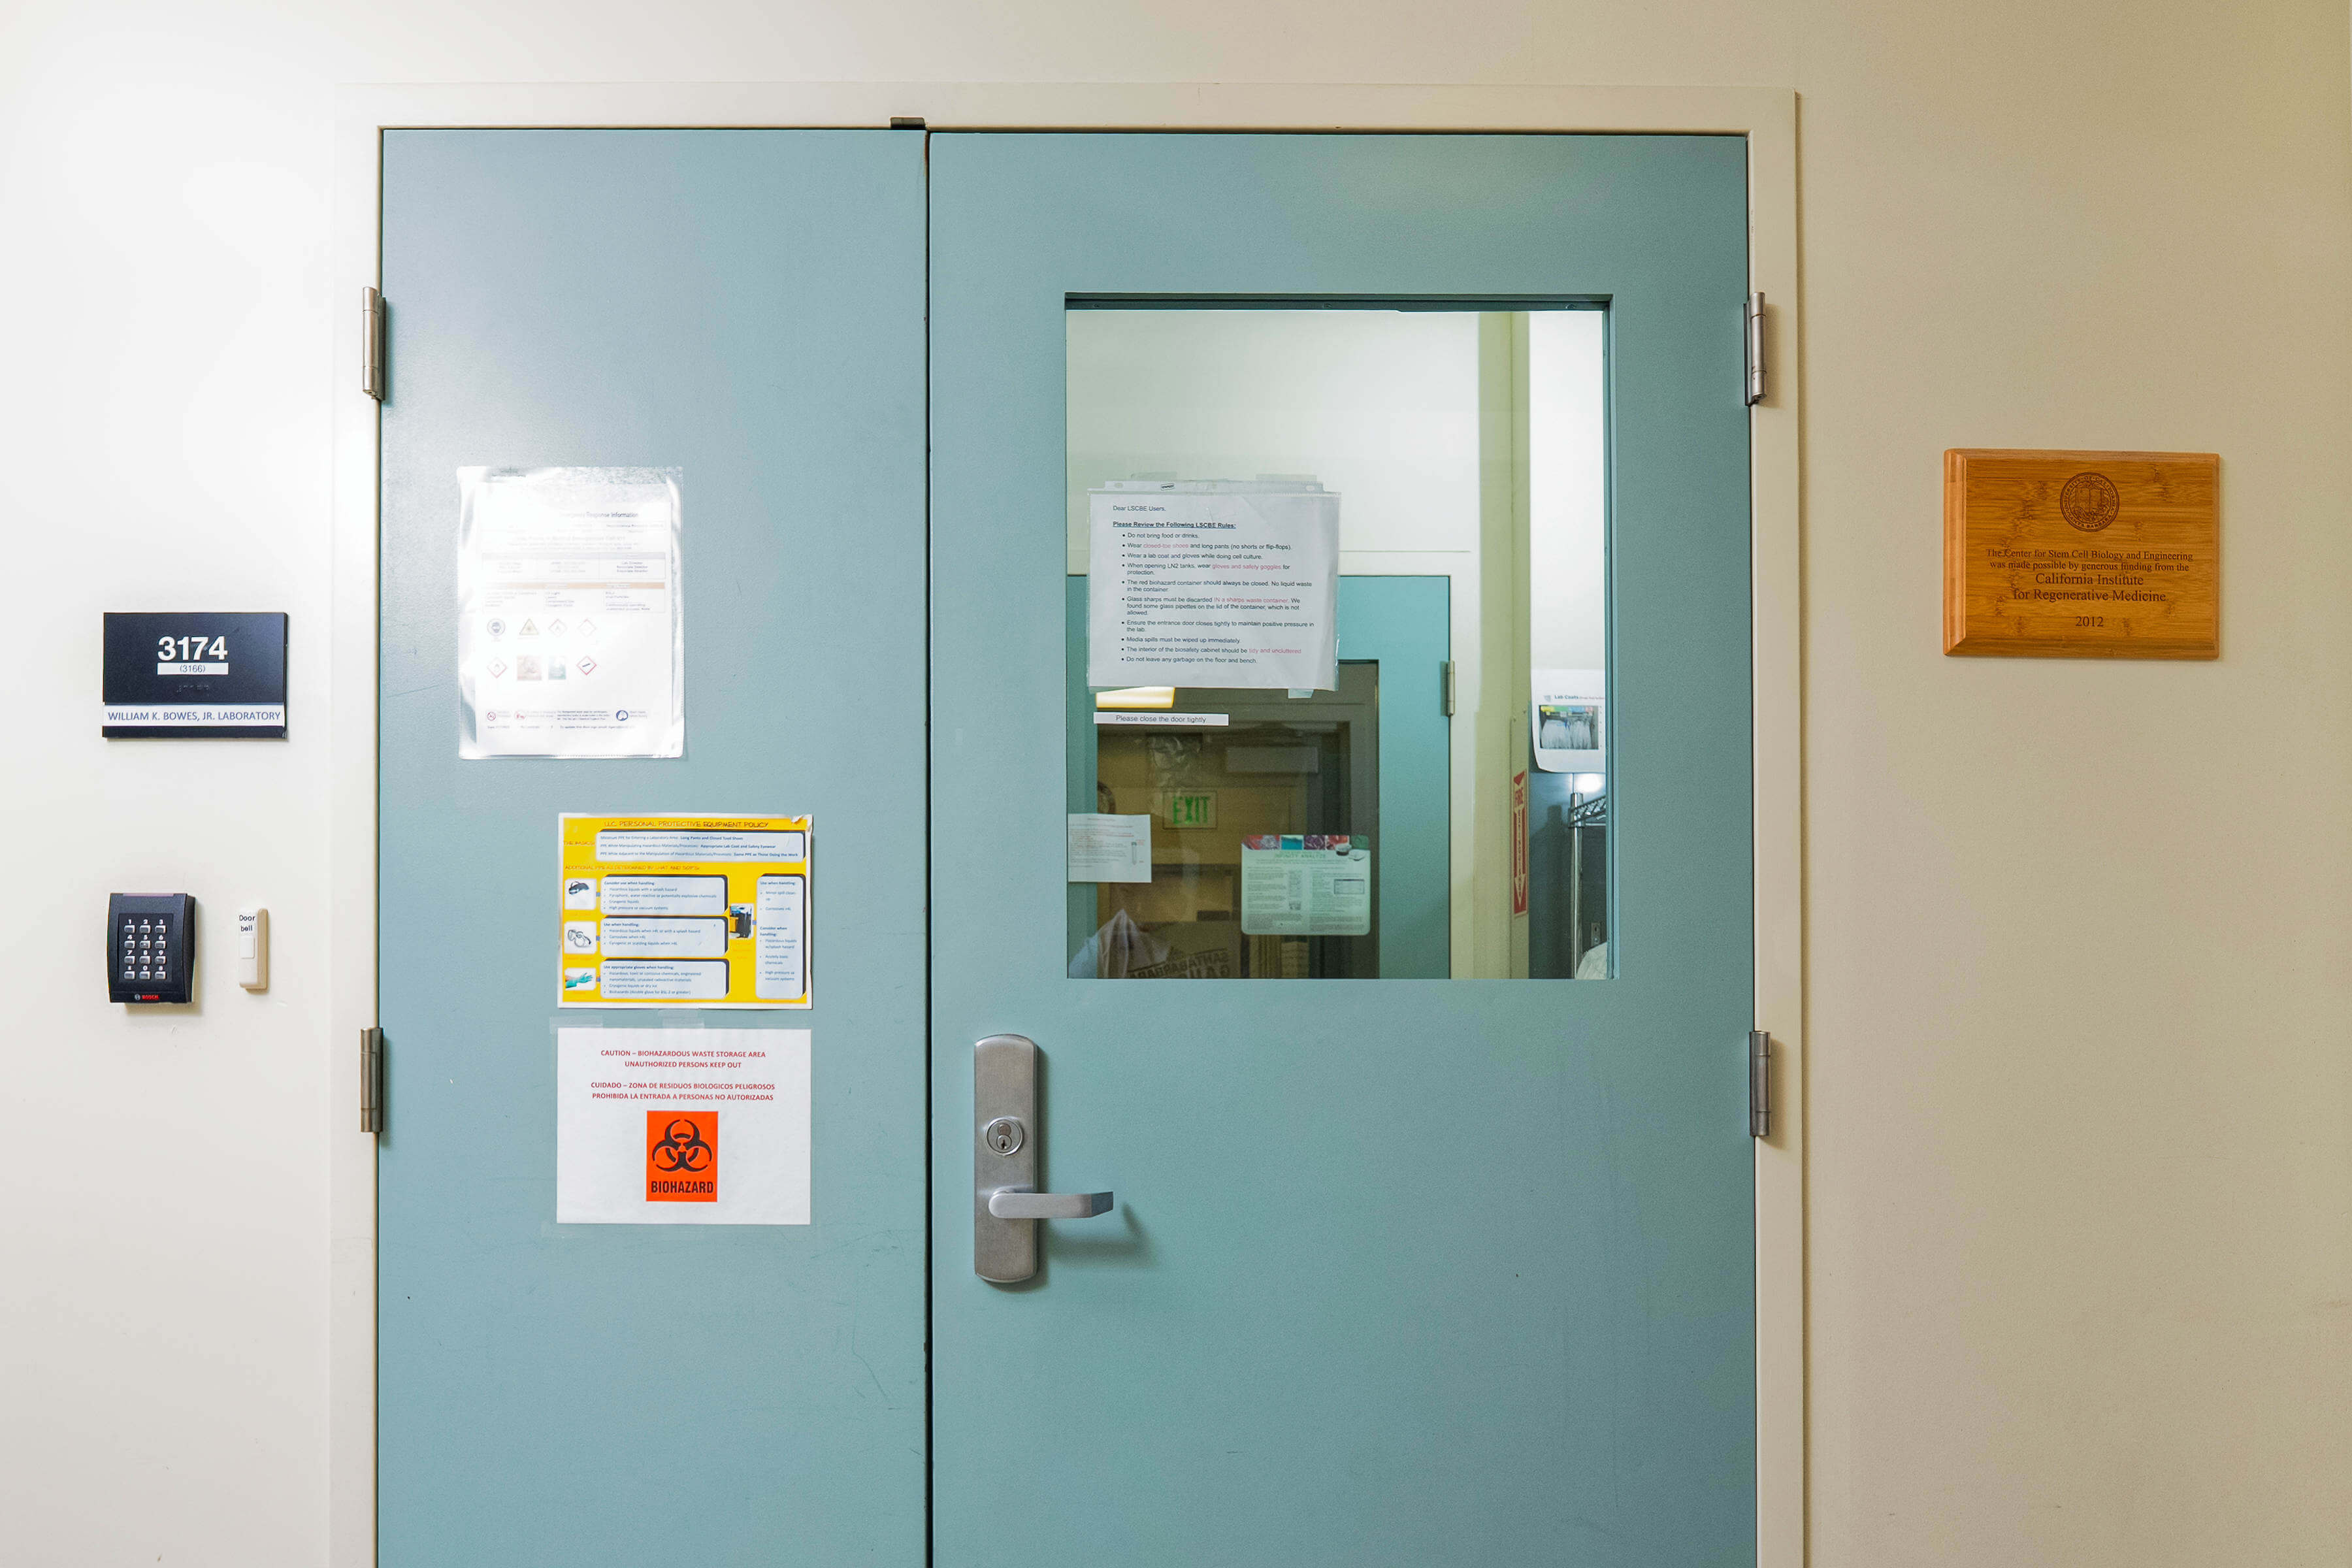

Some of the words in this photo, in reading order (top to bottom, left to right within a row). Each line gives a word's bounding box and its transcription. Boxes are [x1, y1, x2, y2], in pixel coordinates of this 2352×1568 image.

[2091, 551, 2123, 561] Biology
[2144, 551, 2193, 561] Engineering
[2068, 561, 2078, 570] by
[2121, 563, 2151, 572] funding
[2035, 573, 2092, 583] California
[2098, 574, 2144, 585] Institute
[2013, 588, 2030, 599] for
[2034, 589, 2108, 602] Regenerative
[2113, 590, 2166, 601] Medicine
[2075, 616, 2104, 627] 2012
[157, 636, 228, 661] 3174
[152, 712, 160, 721] K.
[163, 712, 200, 721] BOWES,
[203, 711, 216, 720] JR.
[1172, 795, 1209, 825] EXIT
[651, 1181, 714, 1193] BIOHAZARD
